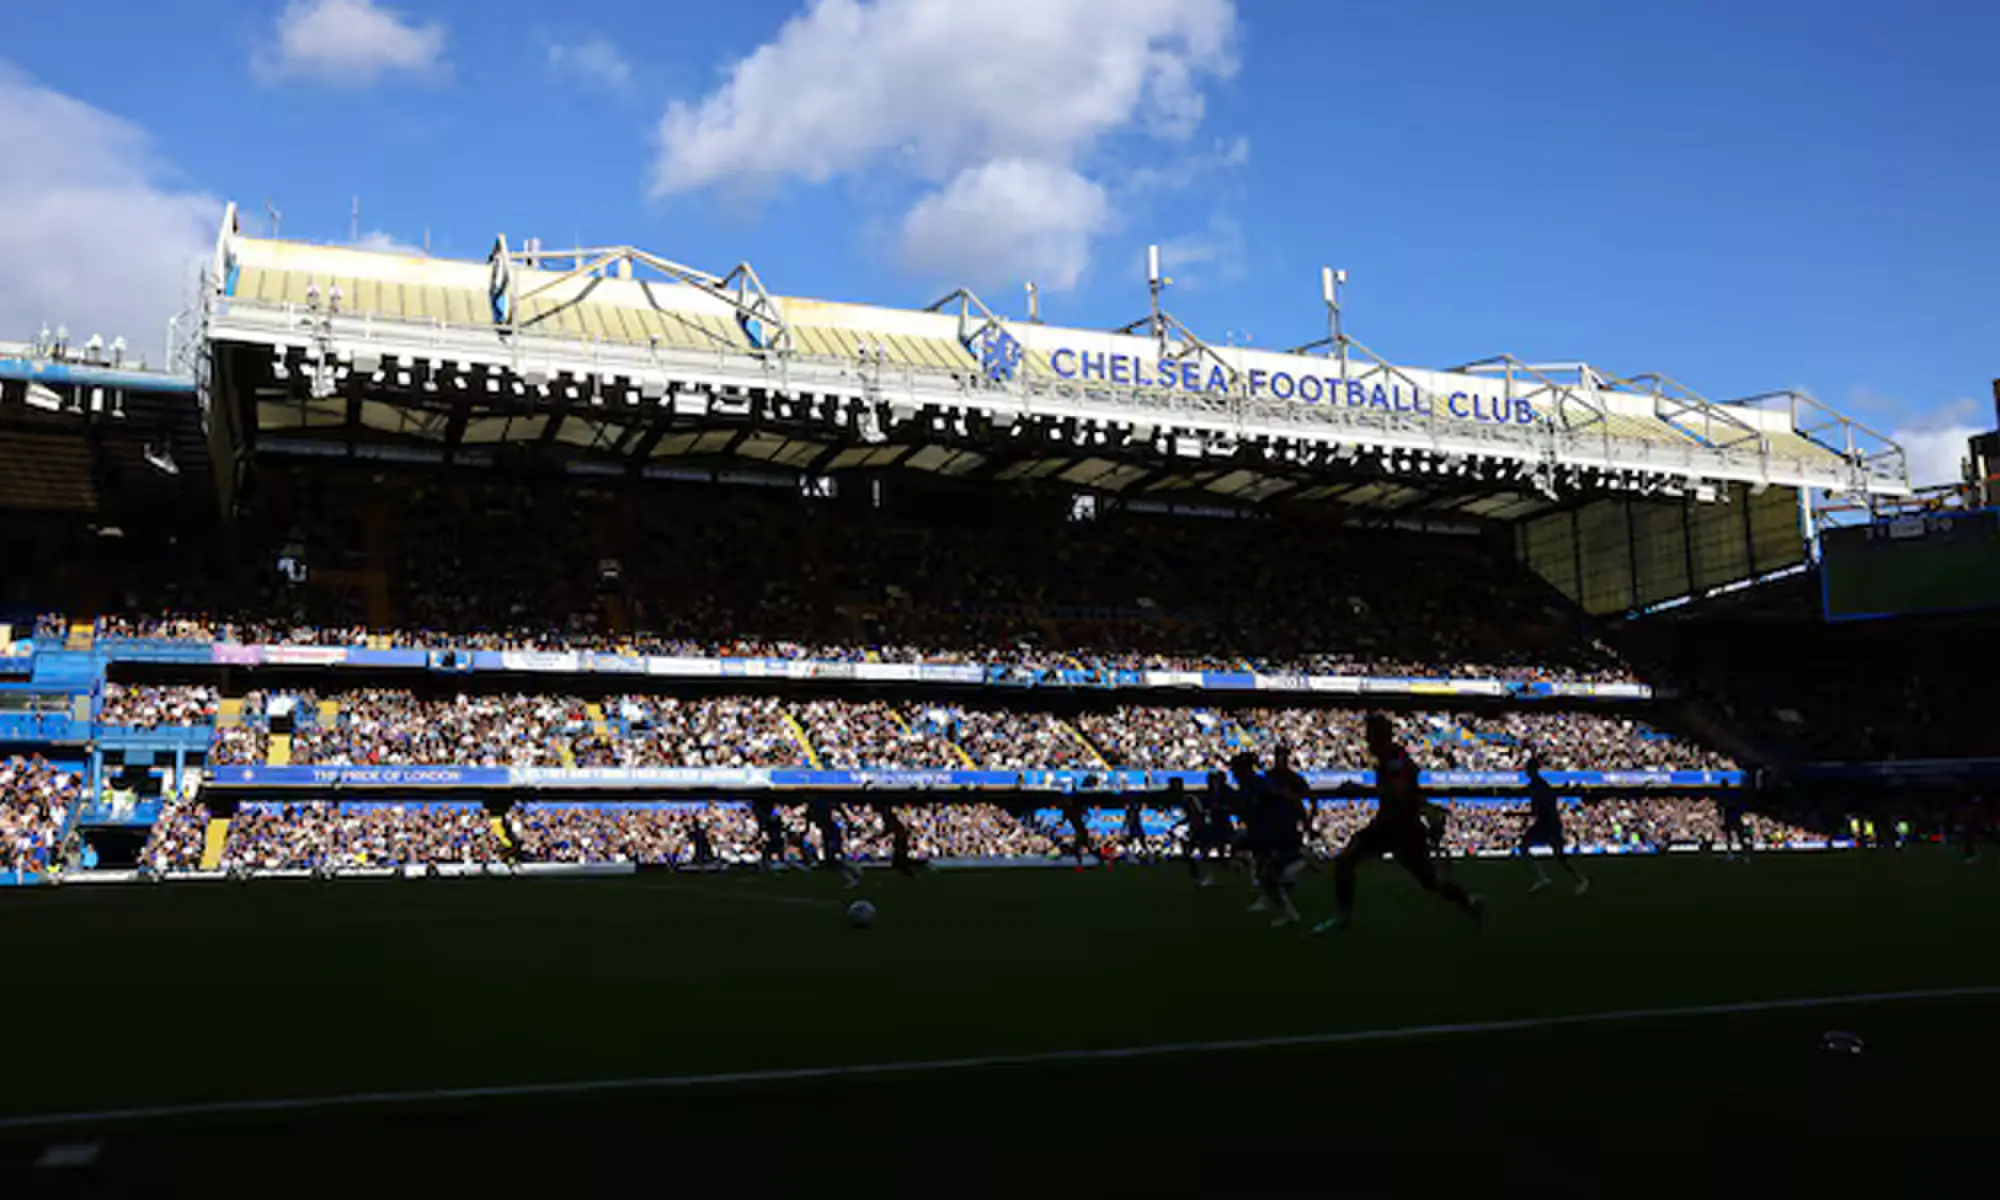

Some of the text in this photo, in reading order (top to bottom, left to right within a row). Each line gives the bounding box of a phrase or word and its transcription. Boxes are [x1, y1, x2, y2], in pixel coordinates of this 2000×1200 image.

[1050, 347, 1532, 423] CHELSEA FOOTBALL CLUB
[383, 770, 400, 781] OF
[403, 770, 460, 781] LONDON
